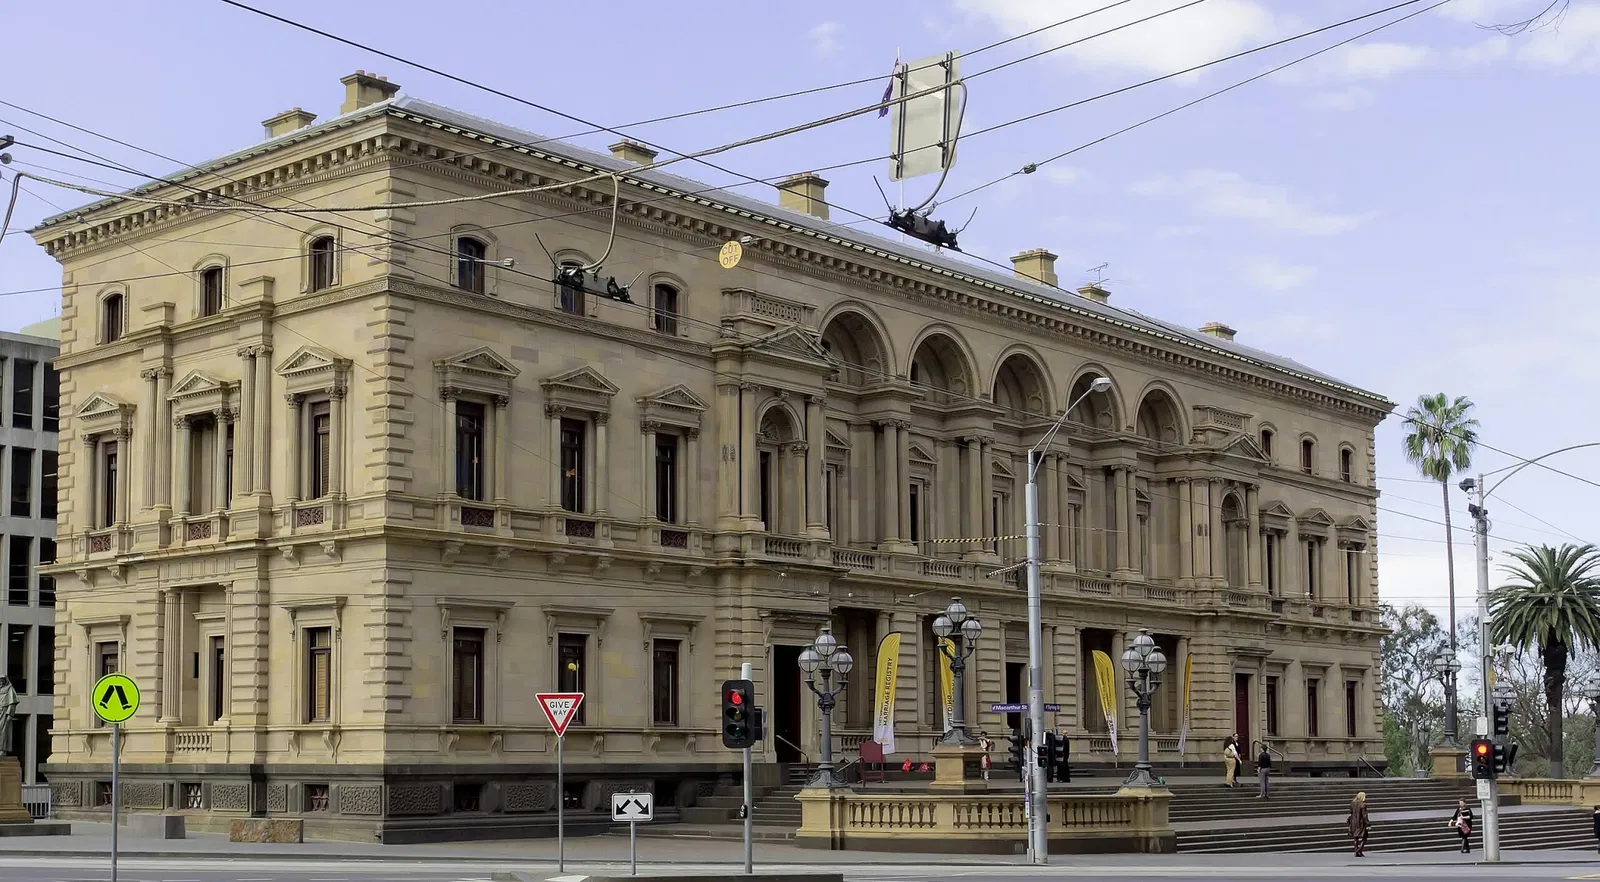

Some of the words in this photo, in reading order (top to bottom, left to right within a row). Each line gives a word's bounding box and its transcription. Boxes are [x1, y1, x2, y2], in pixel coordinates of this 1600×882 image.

[722, 245, 738, 255] CUT
[722, 254, 739, 266] OFF
[885, 657, 893, 689] REGISTRY
